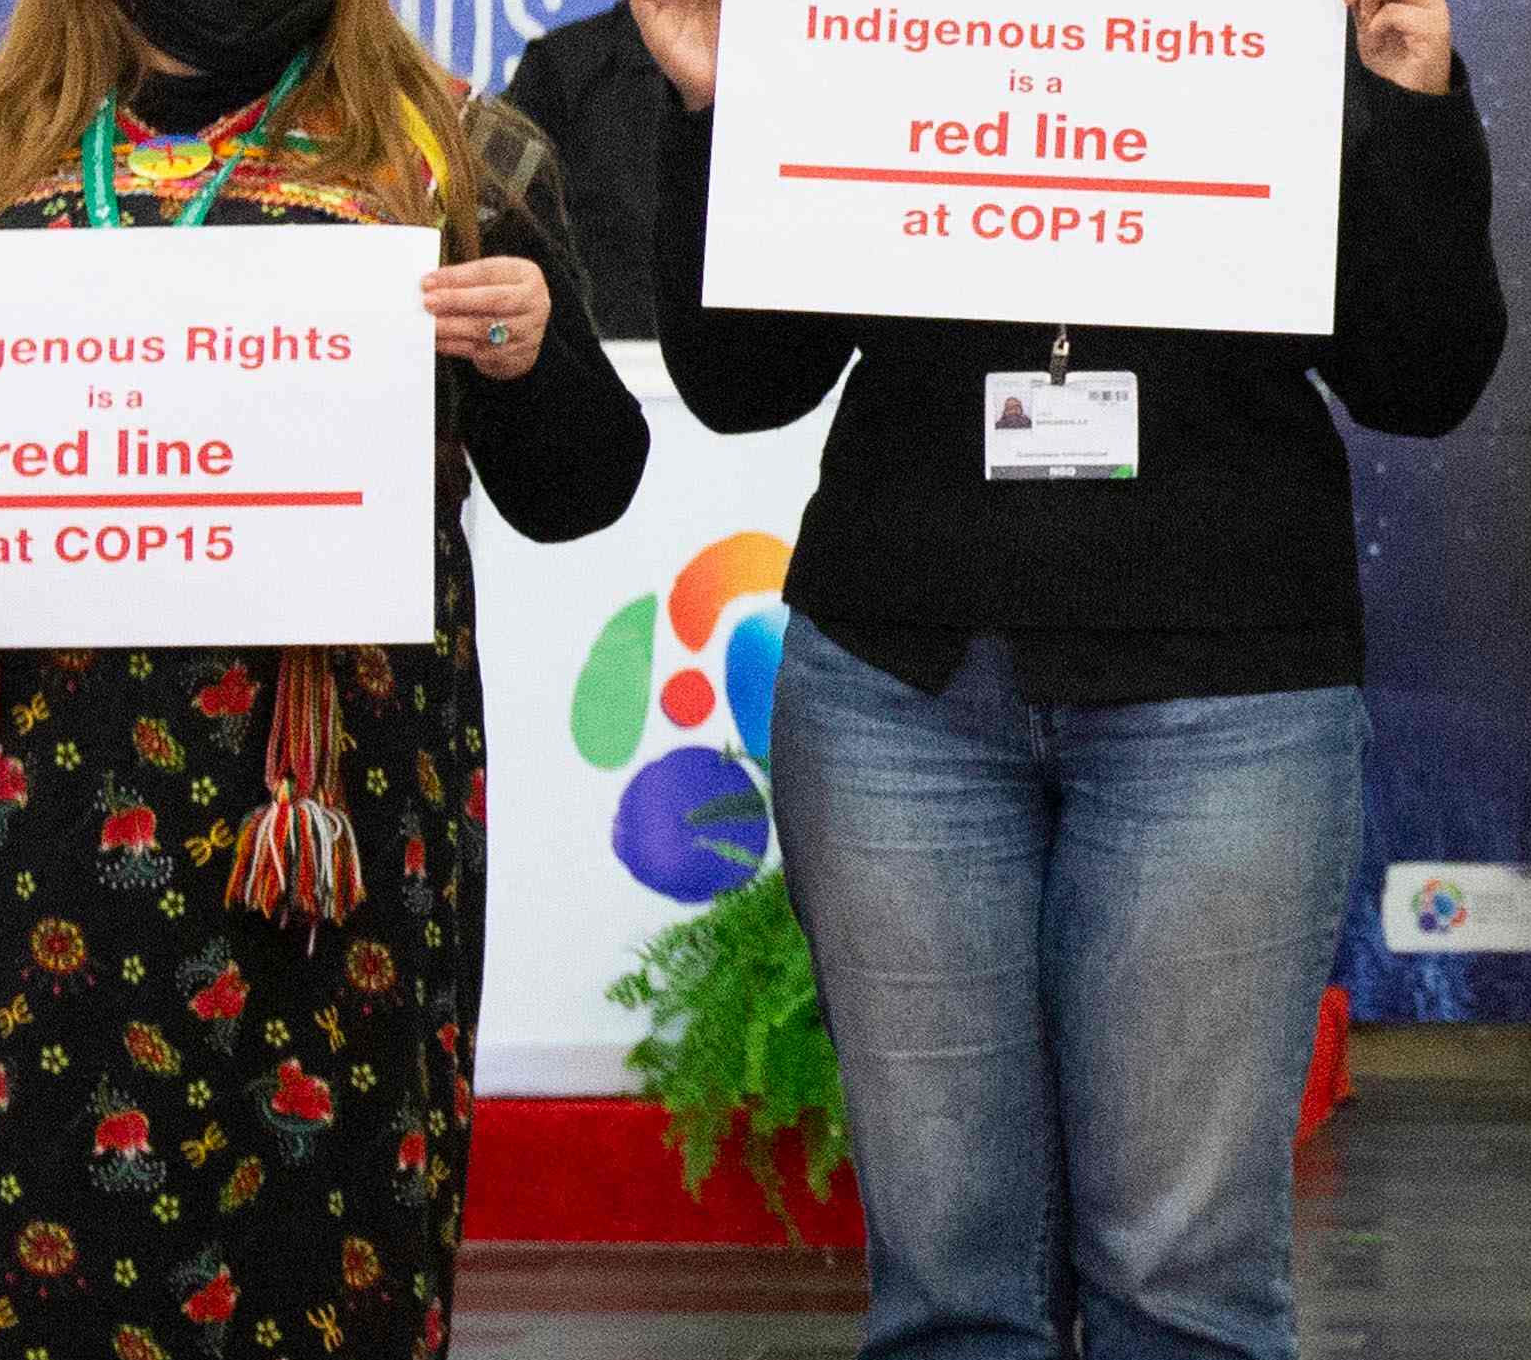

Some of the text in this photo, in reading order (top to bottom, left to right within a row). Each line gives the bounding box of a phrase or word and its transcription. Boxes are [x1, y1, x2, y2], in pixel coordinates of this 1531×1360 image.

[806, 4, 1266, 64] Indigenous Rights
[1008, 68, 1063, 96] is a
[909, 110, 1149, 164] red line
[902, 202, 1145, 246] at COP15
[185, 325, 352, 371] Rights
[86, 384, 144, 410] is a
[116, 429, 234, 478] line
[53, 524, 234, 564] COP15
